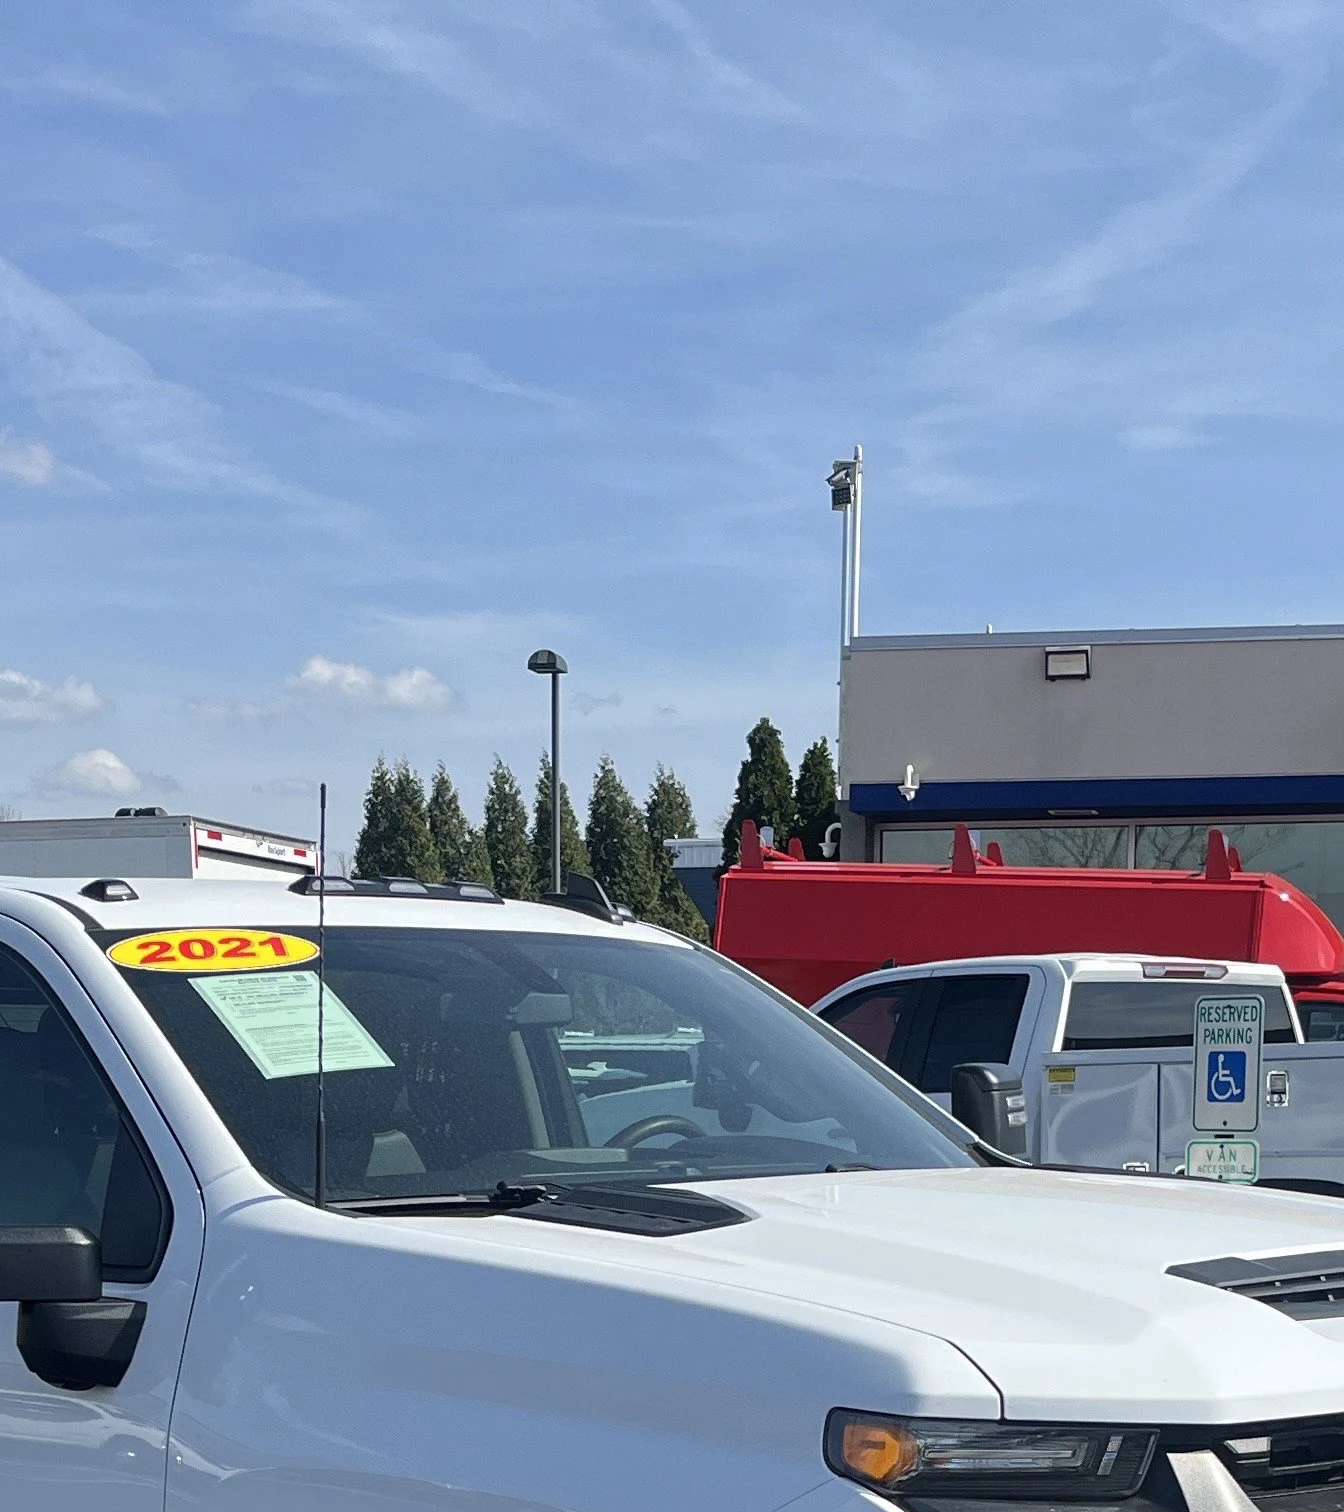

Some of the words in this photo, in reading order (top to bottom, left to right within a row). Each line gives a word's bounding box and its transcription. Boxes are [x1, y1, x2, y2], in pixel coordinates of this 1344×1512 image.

[136, 936, 289, 964] 2021
[1199, 1004, 1258, 1023] RESERVED
[1203, 1027, 1253, 1045] PARKING
[1206, 1149, 1238, 1162] VAN
[1197, 1164, 1248, 1175] ACCESSIBLE
